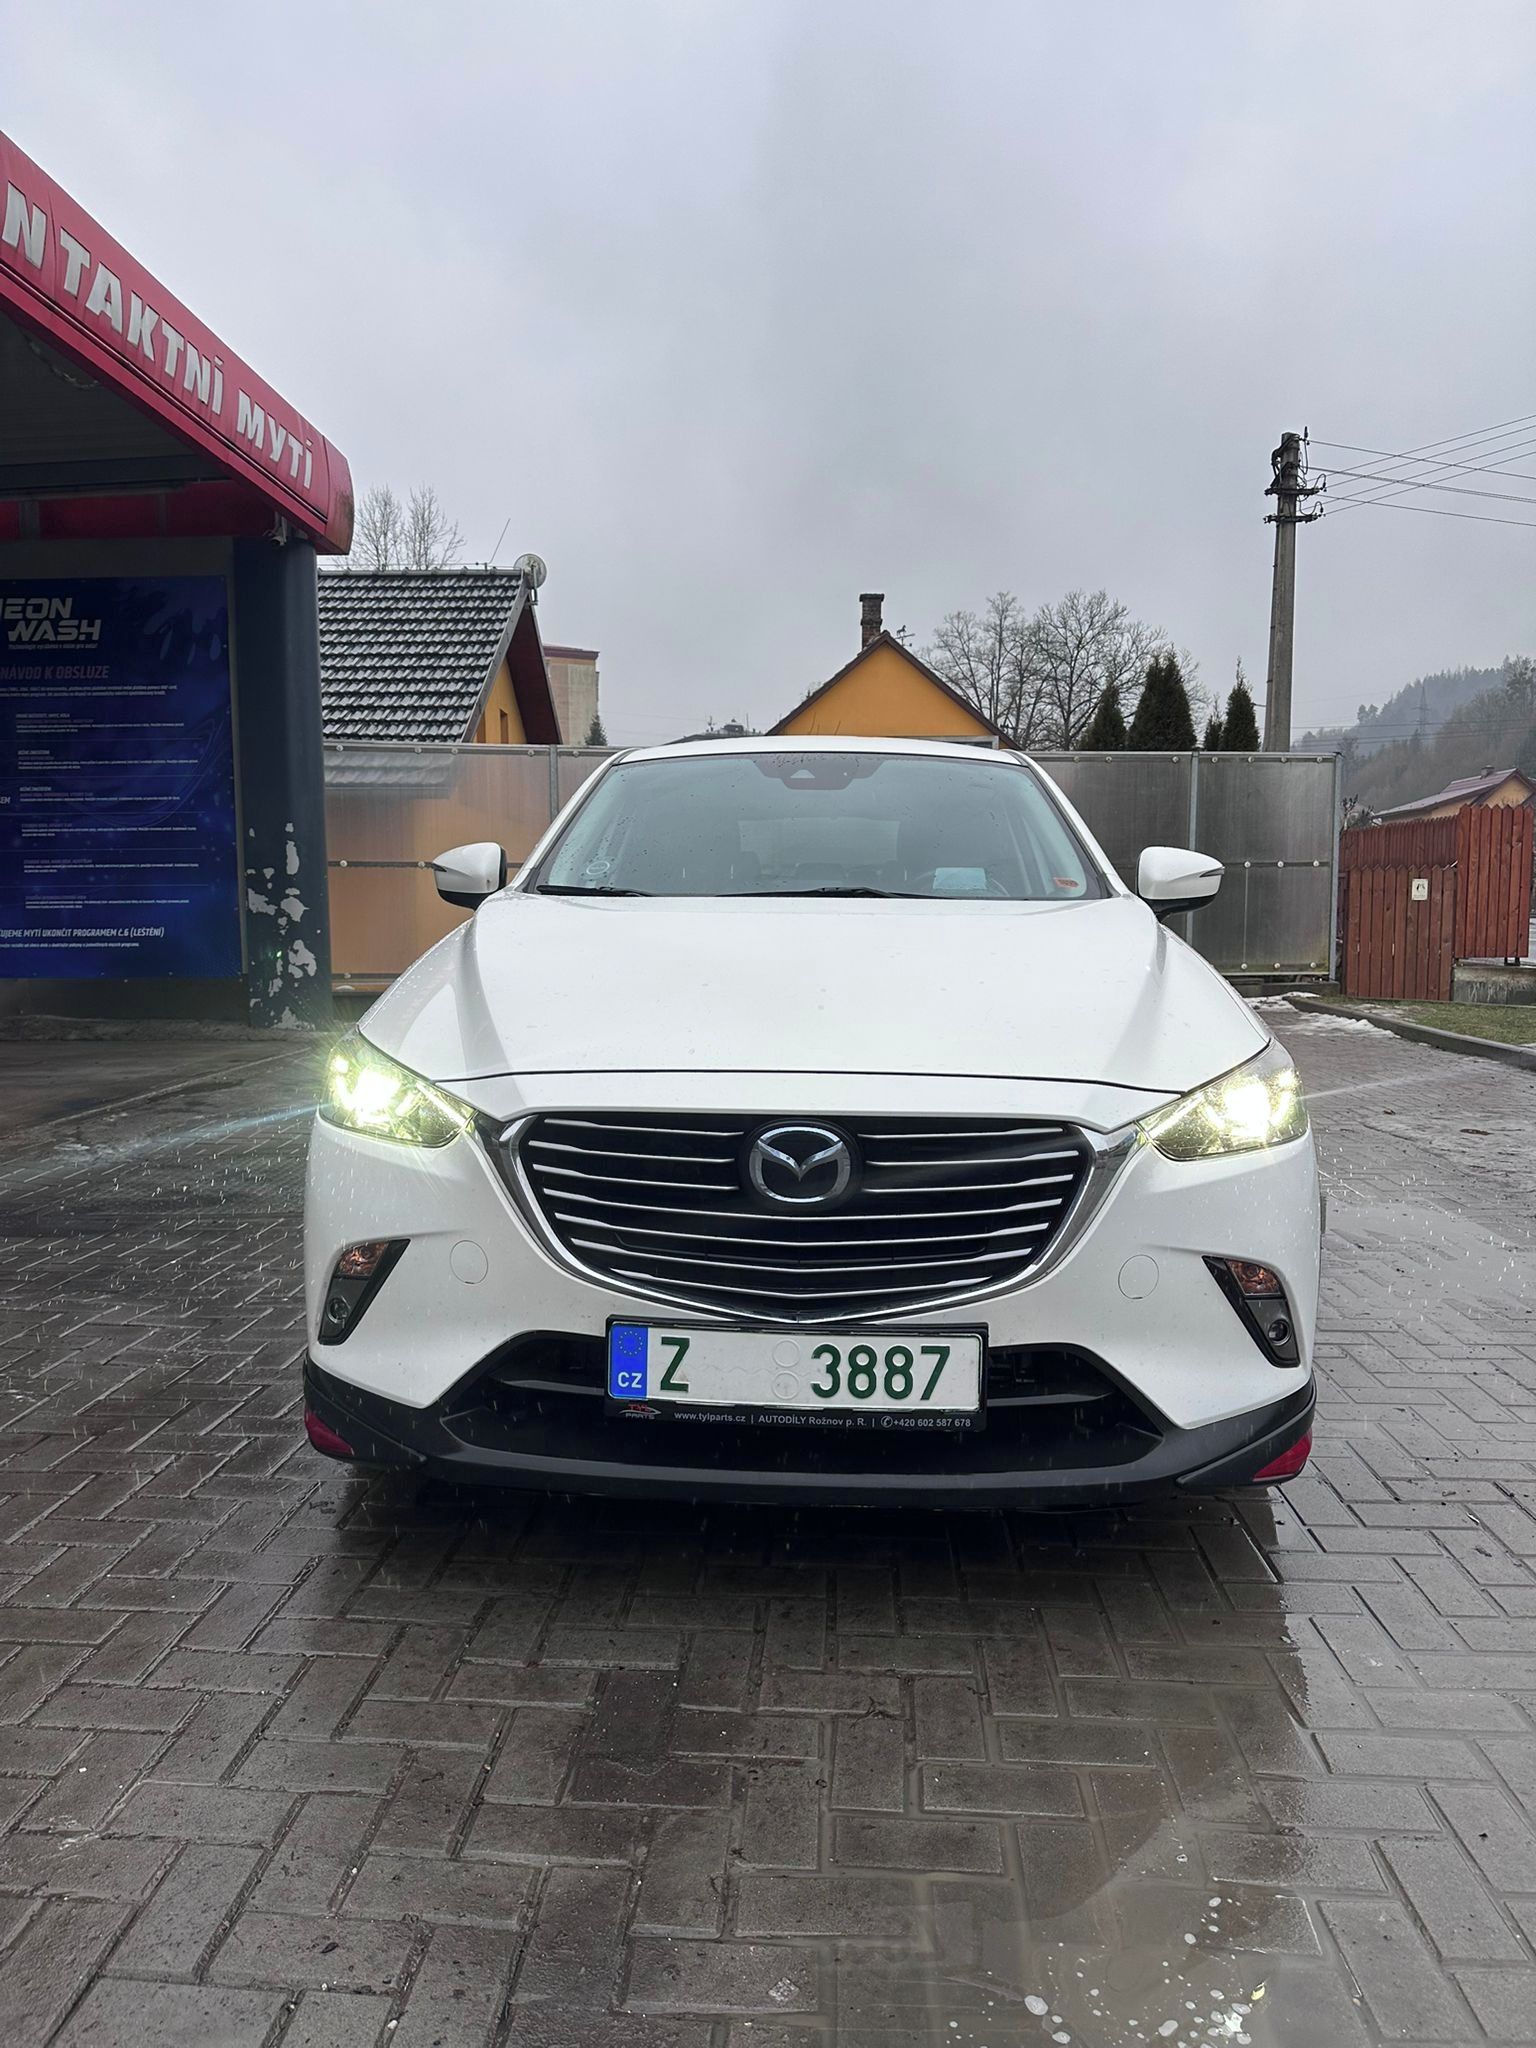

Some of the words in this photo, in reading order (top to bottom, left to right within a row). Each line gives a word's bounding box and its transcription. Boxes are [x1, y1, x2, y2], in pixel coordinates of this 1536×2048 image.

[0, 597, 73, 619] EON
[8, 619, 102, 641] WASH
[44, 665, 54, 680] K
[55, 664, 110, 679] OBSLUZE
[0, 928, 23, 939] UJEME
[73, 928, 117, 937] PROGRAMEM
[659, 1336, 691, 1393] Z
[810, 1343, 951, 1401] 3887
[617, 1371, 643, 1389] CZ
[674, 1411, 746, 1423] www.tylparts.cz
[758, 1413, 807, 1425] AUTODÍLY
[808, 1416, 844, 1426] Rožnov
[846, 1418, 855, 1427] p.
[857, 1417, 867, 1426] R.
[893, 1418, 915, 1427] +420
[917, 1418, 934, 1427] 602
[936, 1419, 953, 1428] 587
[954, 1419, 971, 1428] 678
